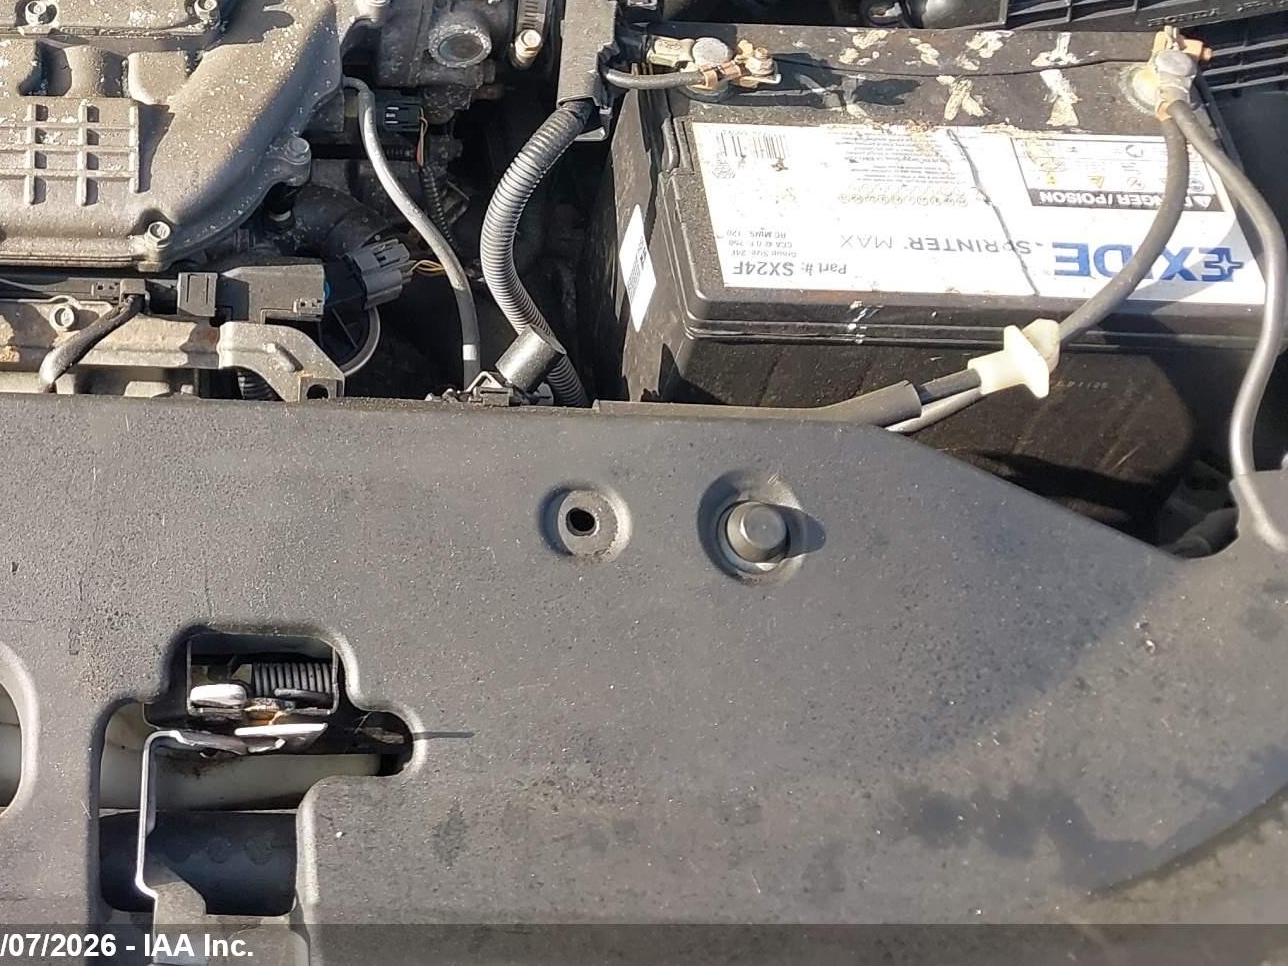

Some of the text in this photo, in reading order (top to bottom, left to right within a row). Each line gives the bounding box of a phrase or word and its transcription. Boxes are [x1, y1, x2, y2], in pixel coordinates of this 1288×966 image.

[841, 234, 893, 249] MAX
[732, 261, 795, 277] SX24F
[818, 263, 847, 275] Part
